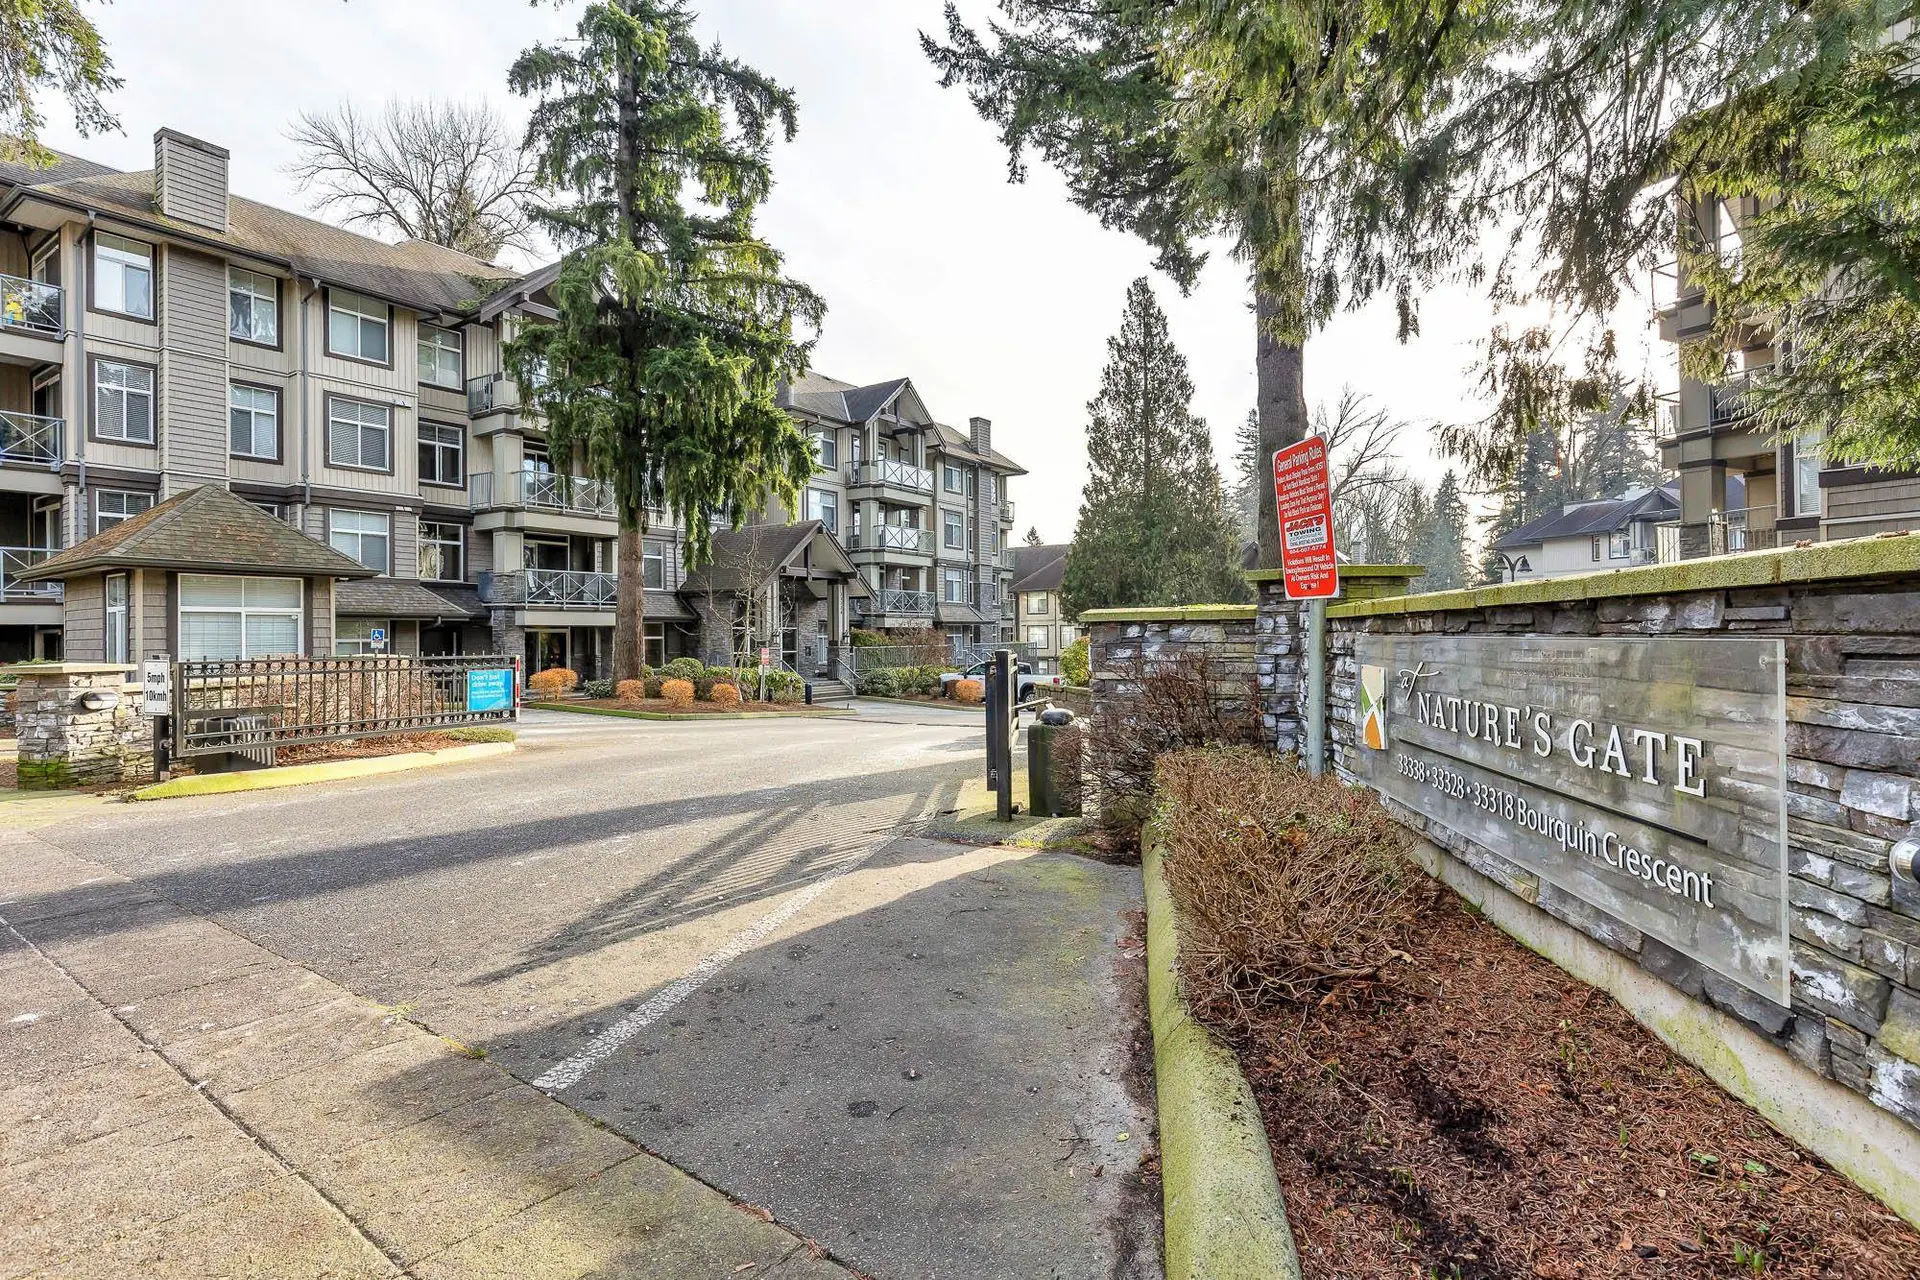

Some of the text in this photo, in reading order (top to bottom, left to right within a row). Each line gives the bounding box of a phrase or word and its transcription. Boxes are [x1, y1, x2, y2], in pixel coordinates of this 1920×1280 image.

[1277, 446, 1322, 472] General Parking Rules
[1286, 515, 1324, 532] JACK'S
[1289, 527, 1321, 537] TOWING
[1287, 557, 1304, 565] Violations
[147, 672, 165, 685] 5mph
[146, 690, 166, 701] 10kmh
[1417, 692, 1707, 798] NATURE'S GATE
[1518, 799, 1599, 858] Bourquin
[1603, 831, 1714, 908] Crescent
